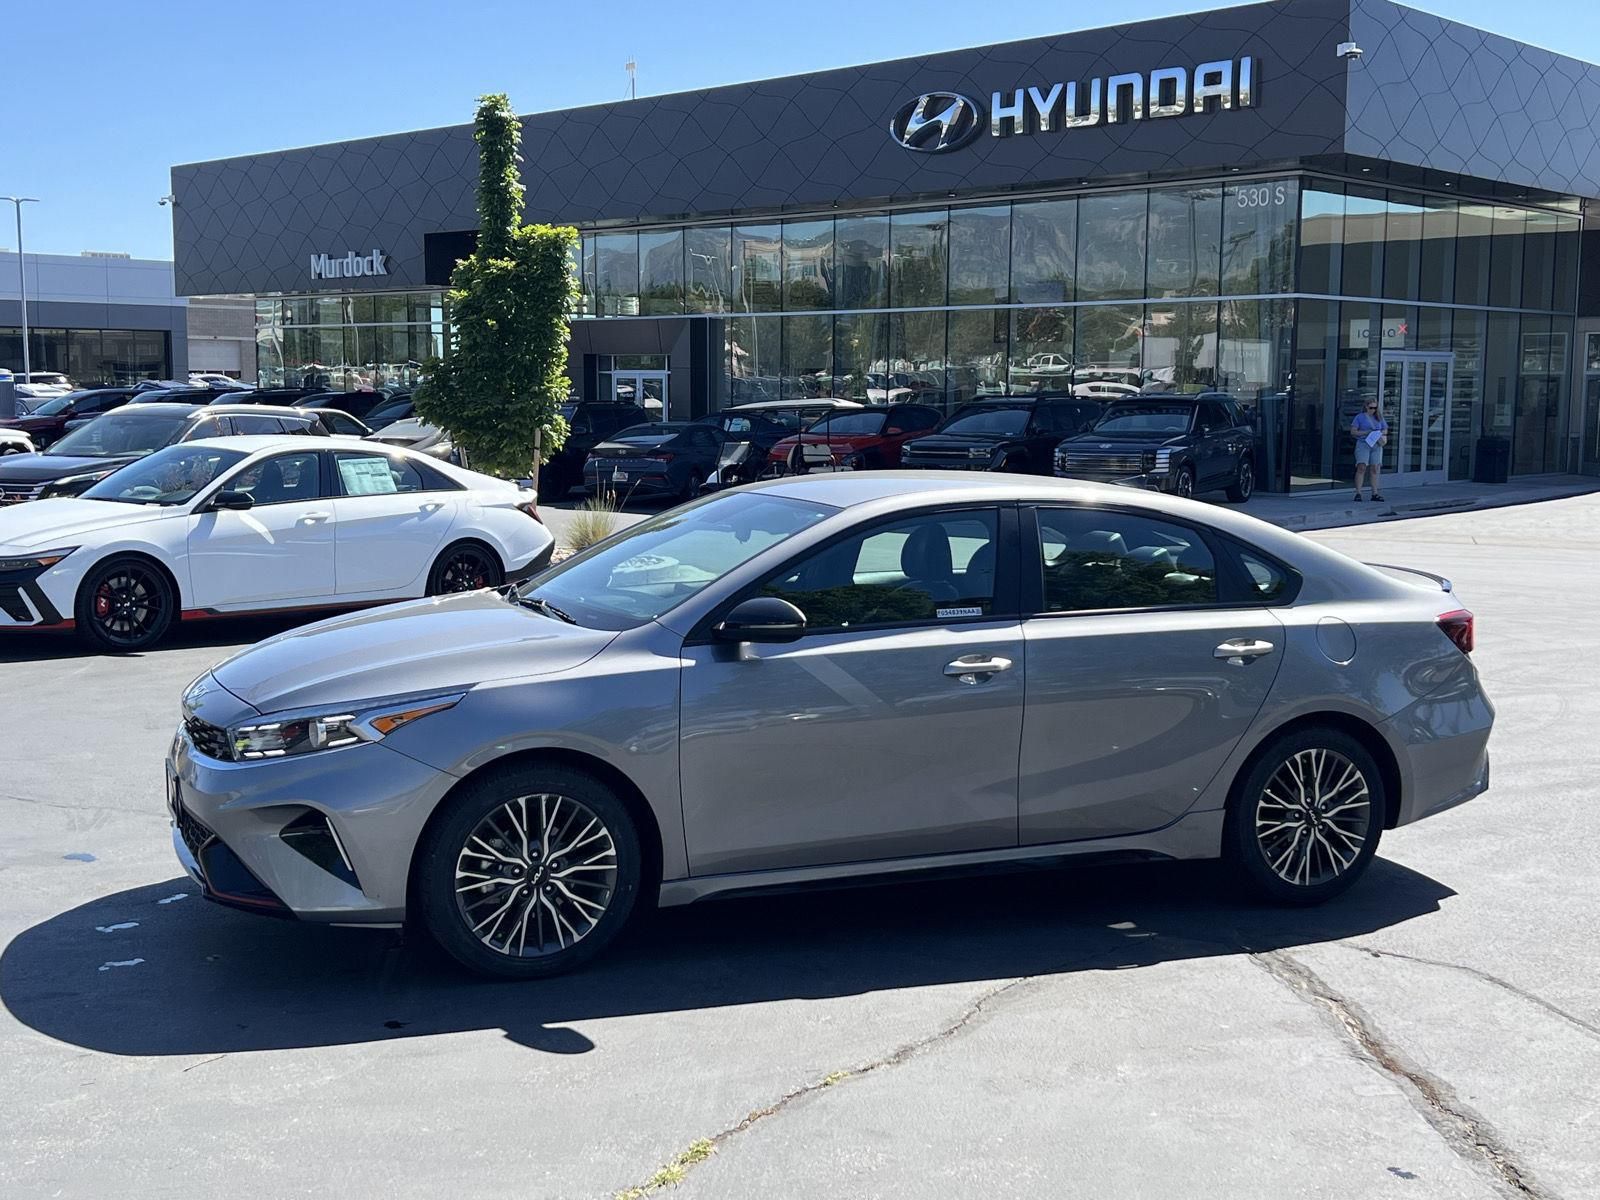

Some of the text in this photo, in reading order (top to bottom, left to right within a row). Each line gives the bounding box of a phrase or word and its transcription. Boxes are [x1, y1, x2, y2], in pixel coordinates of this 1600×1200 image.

[990, 56, 1254, 137] HYUNDAI
[1237, 186, 1285, 208] 530 S
[310, 248, 388, 280] Murdock
